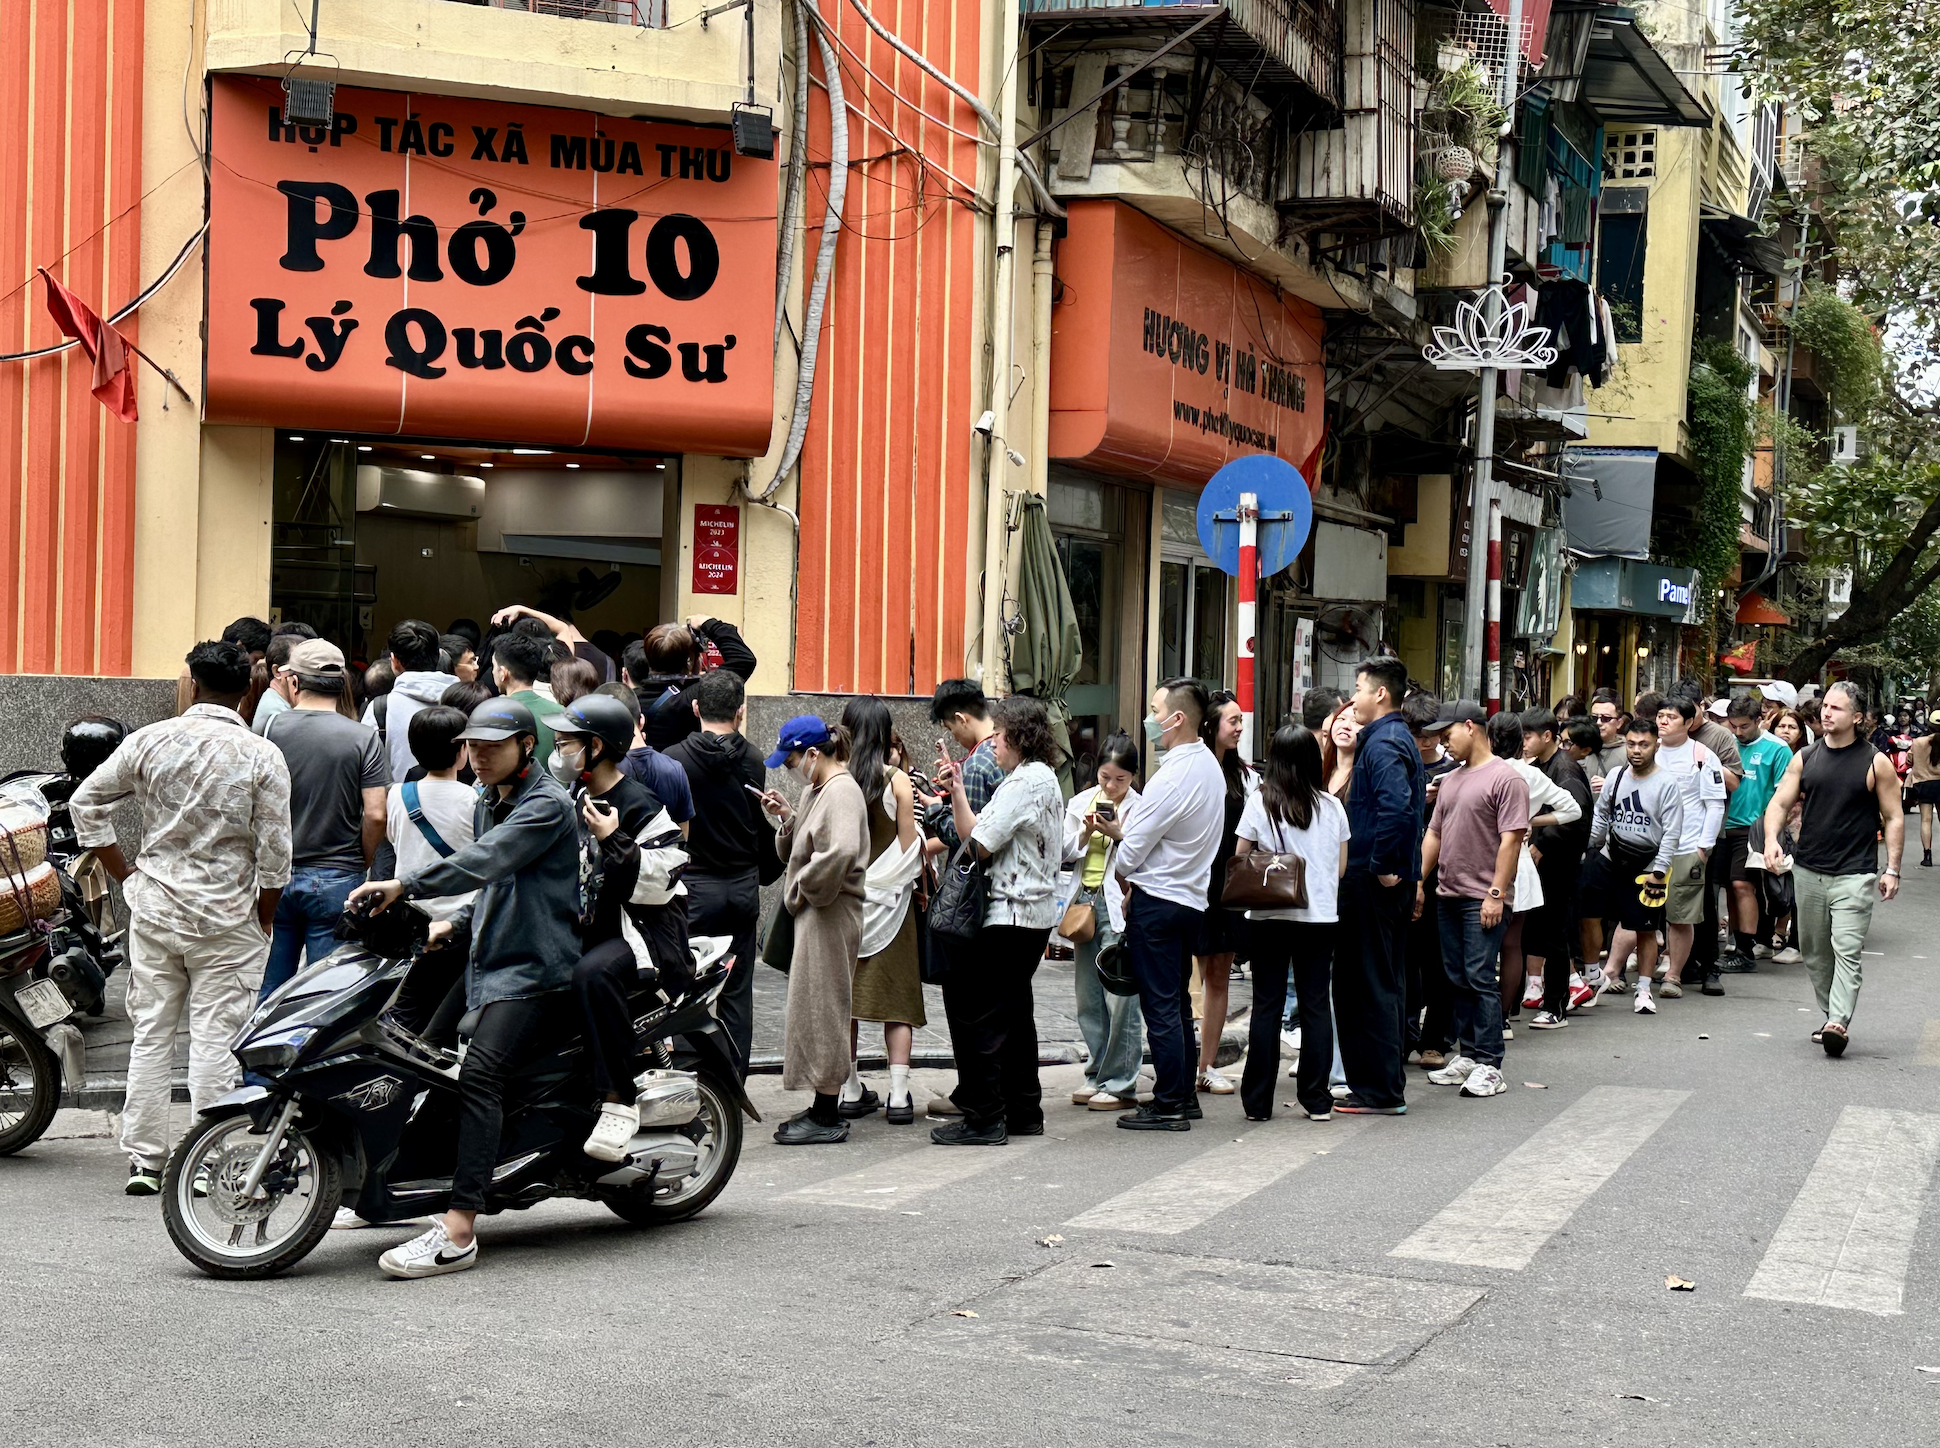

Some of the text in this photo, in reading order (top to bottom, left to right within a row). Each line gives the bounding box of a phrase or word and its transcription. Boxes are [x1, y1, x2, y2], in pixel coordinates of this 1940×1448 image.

[374, 112, 455, 158] TÁC
[470, 122, 529, 165] XÃ
[550, 132, 644, 176] MÙA
[655, 143, 732, 183] THU
[277, 179, 721, 302] Phở 10
[249, 297, 737, 384] Lý Quốc Sư
[1144, 307, 1209, 375] HƯƠNG
[1215, 340, 1231, 400] VỊ
[1234, 342, 1257, 395] HÀ
[699, 520, 735, 529] MICHELIN
[709, 528, 725, 536] 2023
[698, 562, 734, 571] MICHELIN
[707, 571, 724, 579] 2024
[1613, 809, 1651, 826] didas
